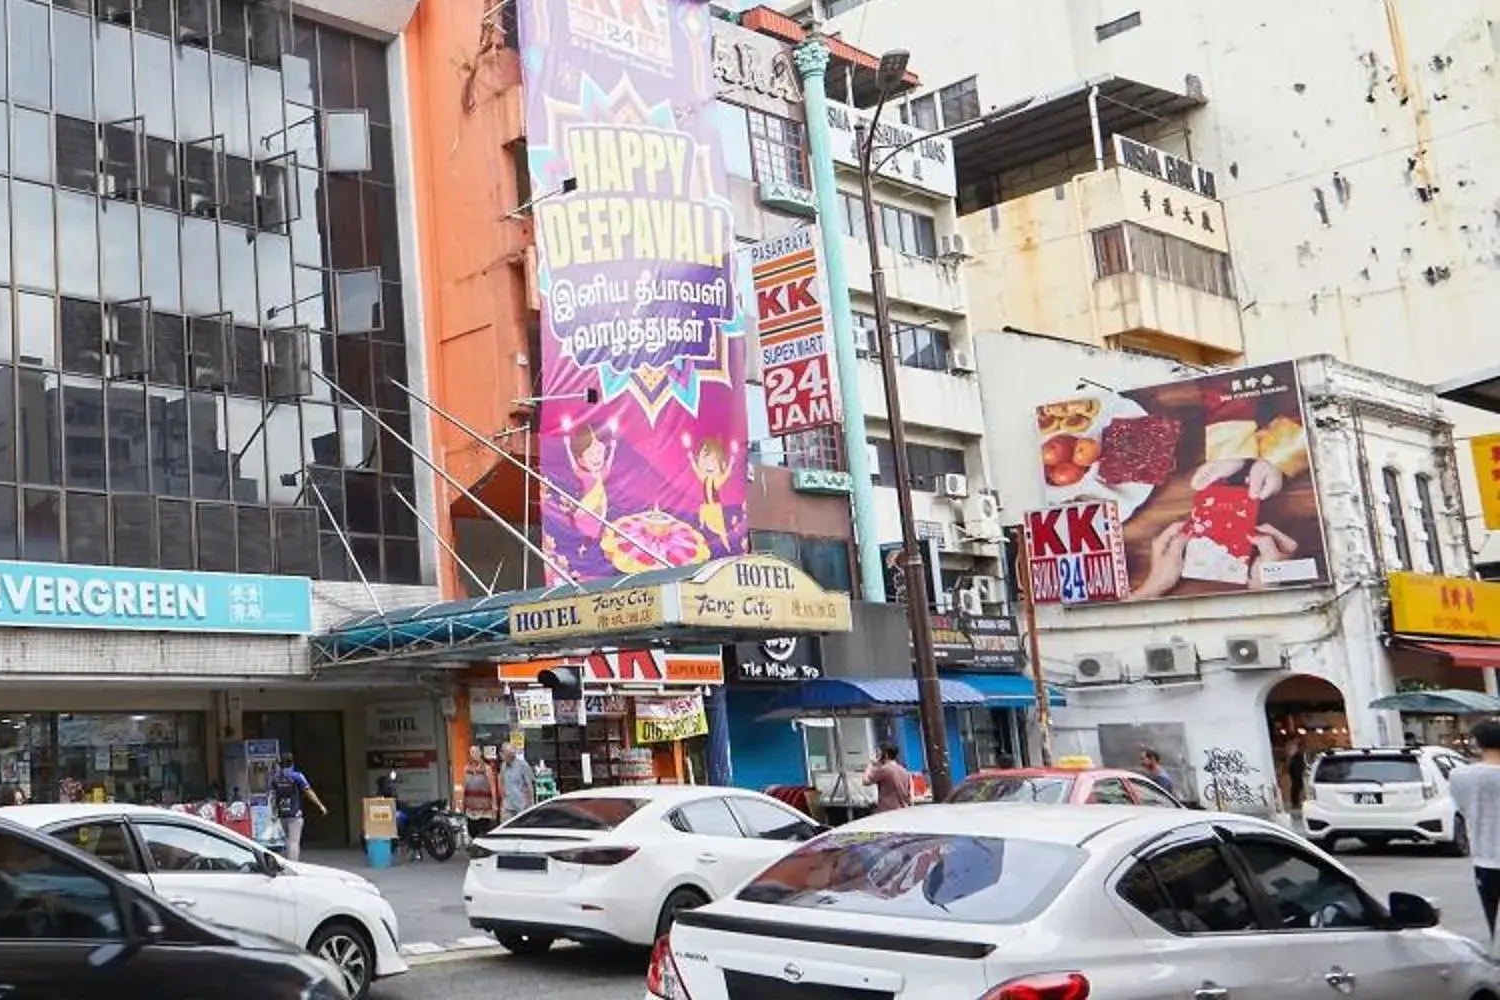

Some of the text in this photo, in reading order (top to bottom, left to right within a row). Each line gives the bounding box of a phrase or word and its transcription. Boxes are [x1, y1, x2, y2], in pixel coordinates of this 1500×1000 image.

[606, 22, 637, 50] 24
[569, 128, 688, 197] HAPPY
[542, 198, 725, 269] DEEPAVALI
[553, 269, 727, 322] இனிய தீபாவளி
[757, 276, 818, 320] KK
[766, 360, 828, 406] 24
[771, 397, 832, 431] JAM
[1030, 503, 1106, 556] KK
[735, 563, 796, 590] HOTEL
[1060, 557, 1087, 599] 24
[515, 605, 581, 633] HOTEL
[592, 590, 656, 612] Tang City
[694, 594, 773, 621] Tang City
